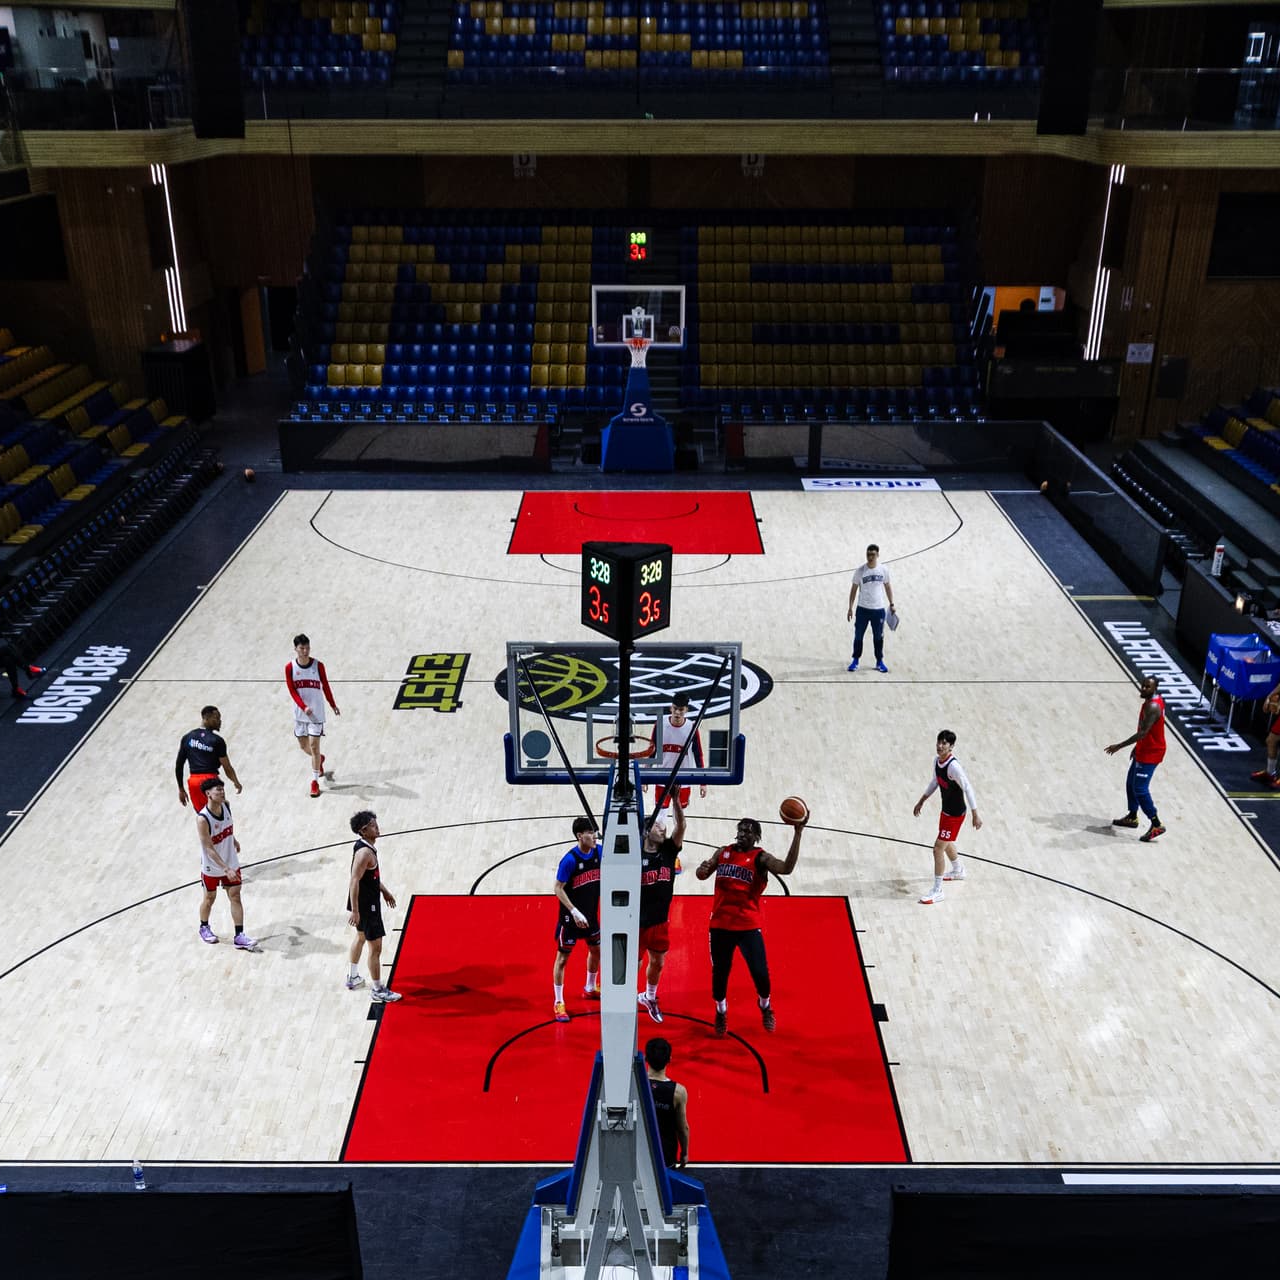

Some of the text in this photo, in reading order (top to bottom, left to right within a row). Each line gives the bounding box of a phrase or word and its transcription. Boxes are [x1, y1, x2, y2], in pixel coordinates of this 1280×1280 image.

[590, 558, 610, 584] 3:28
[641, 560, 662, 586] 3:28
[589, 586, 609, 623] 3.5
[640, 592, 661, 627] 3.5
[16, 645, 131, 724] #BCLASIA
[940, 829, 952, 839] 55
